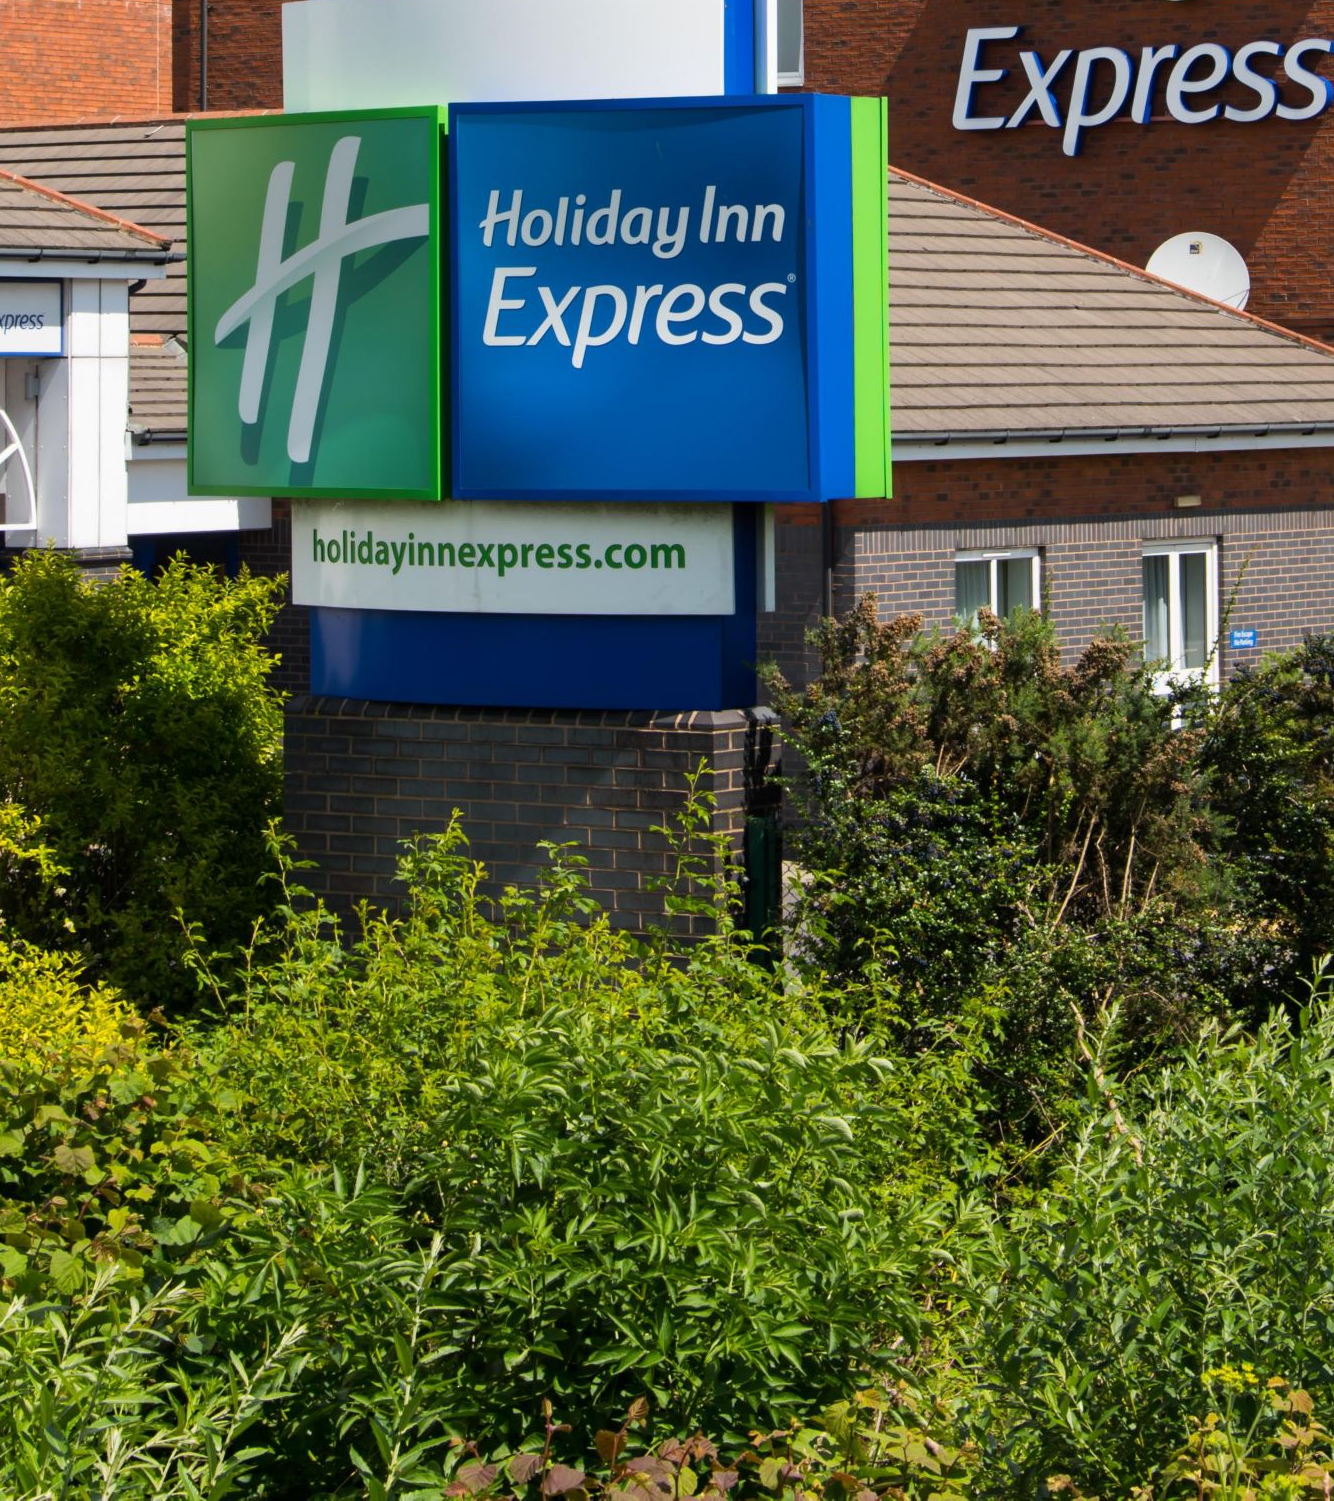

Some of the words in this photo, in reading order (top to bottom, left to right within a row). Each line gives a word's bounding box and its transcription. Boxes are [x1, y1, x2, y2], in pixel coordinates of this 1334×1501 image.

[479, 188, 690, 259] Holiday
[699, 185, 786, 244] Inn
[313, 528, 687, 577] holidayinnexpress.com
